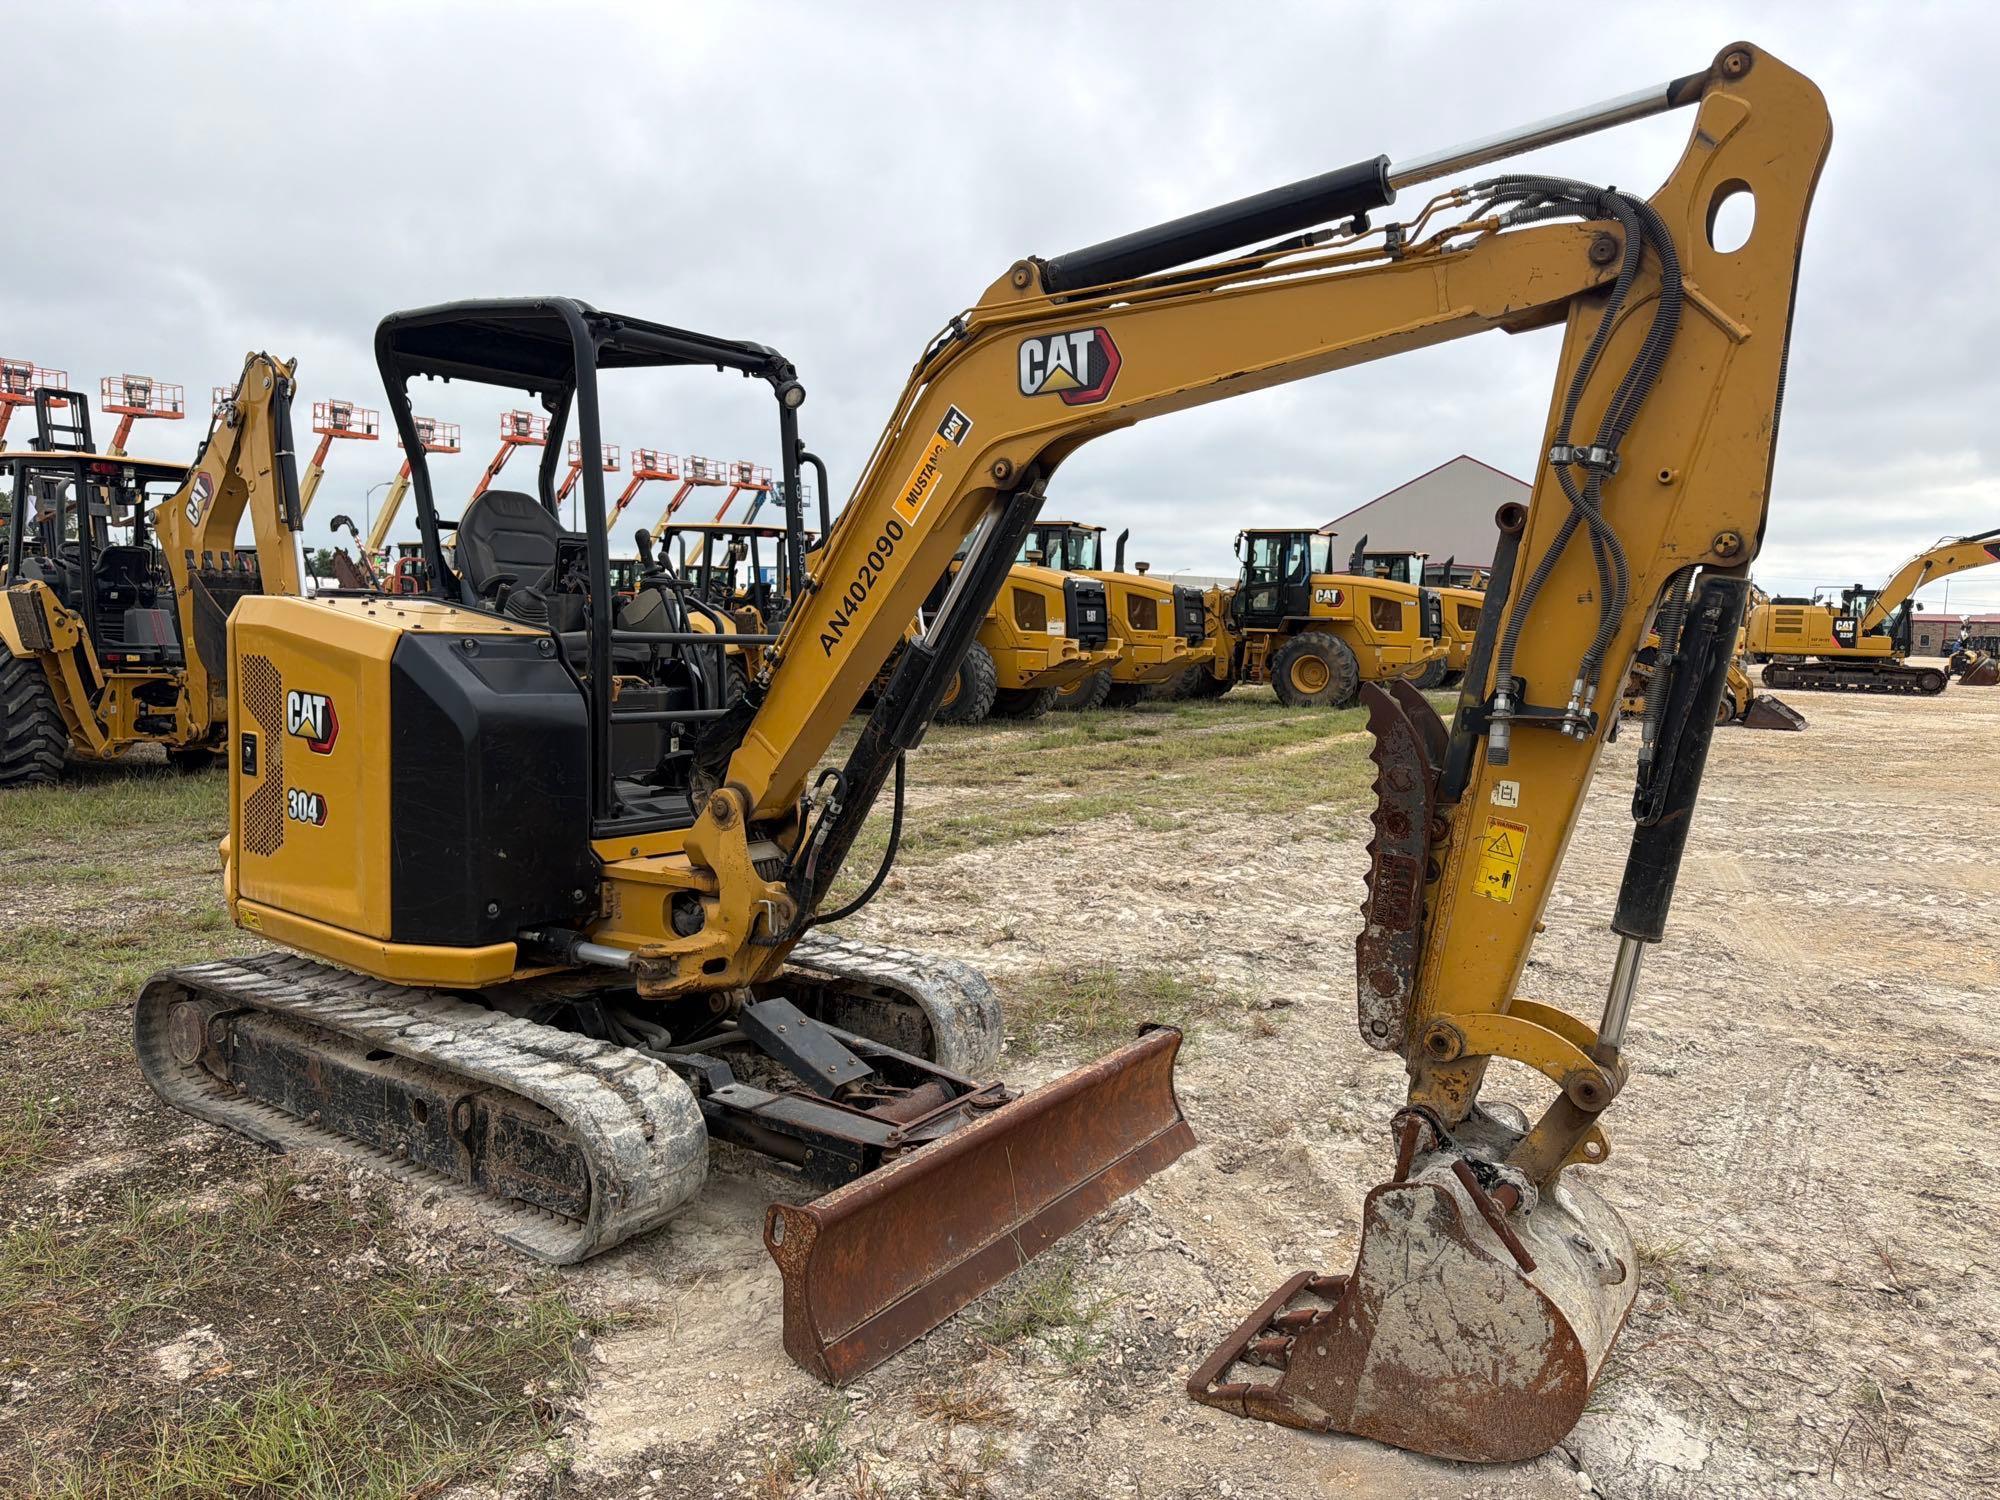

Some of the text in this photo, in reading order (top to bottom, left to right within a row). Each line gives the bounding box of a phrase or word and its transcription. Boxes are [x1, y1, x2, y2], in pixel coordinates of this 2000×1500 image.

[1020, 330, 1095, 394] CAT
[943, 413, 964, 441] CAT
[185, 477, 209, 525] CAT
[819, 519, 904, 658] AN402090
[1315, 589, 1338, 603] CAT
[1835, 621, 1855, 631] CAT
[287, 691, 326, 740] CAT
[288, 789, 318, 824] 304
[1496, 820, 1525, 833] WARNING
